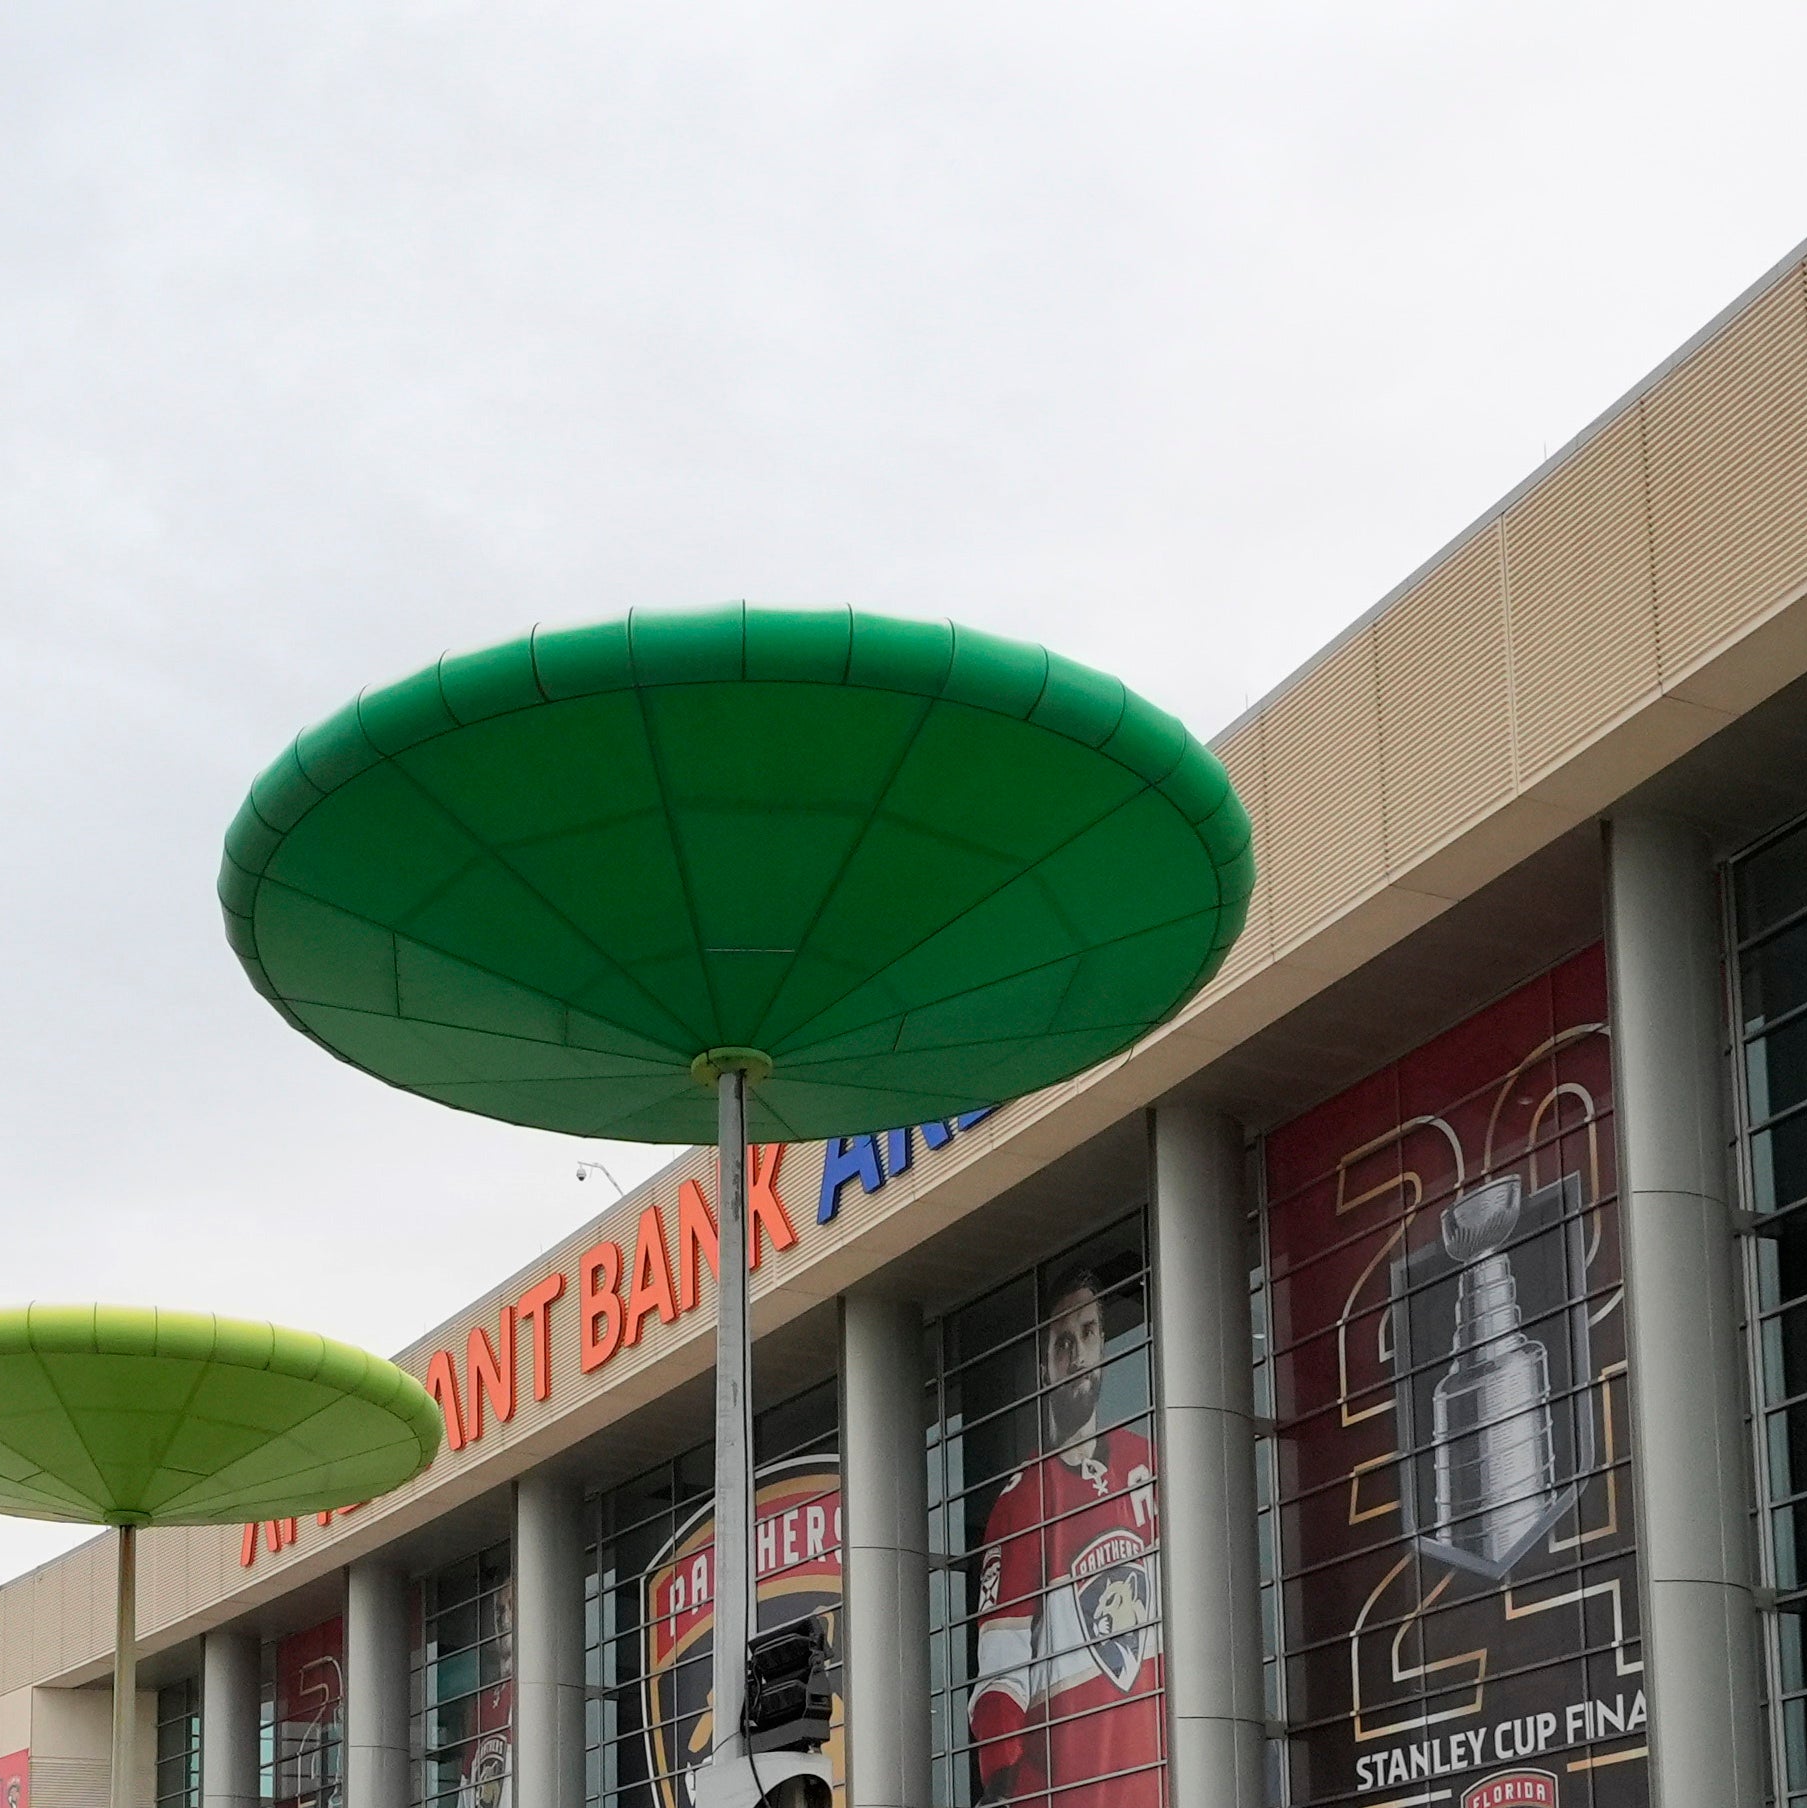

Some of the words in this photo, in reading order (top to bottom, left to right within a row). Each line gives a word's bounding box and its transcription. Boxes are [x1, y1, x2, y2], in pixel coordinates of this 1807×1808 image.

[580, 1144, 795, 1374] BANK
[669, 1506, 841, 1637] PAHER
[1080, 1539, 1142, 1577] PANTHERS
[1356, 1727, 1487, 1792] STANLEY
[1494, 1712, 1556, 1760] CUP
